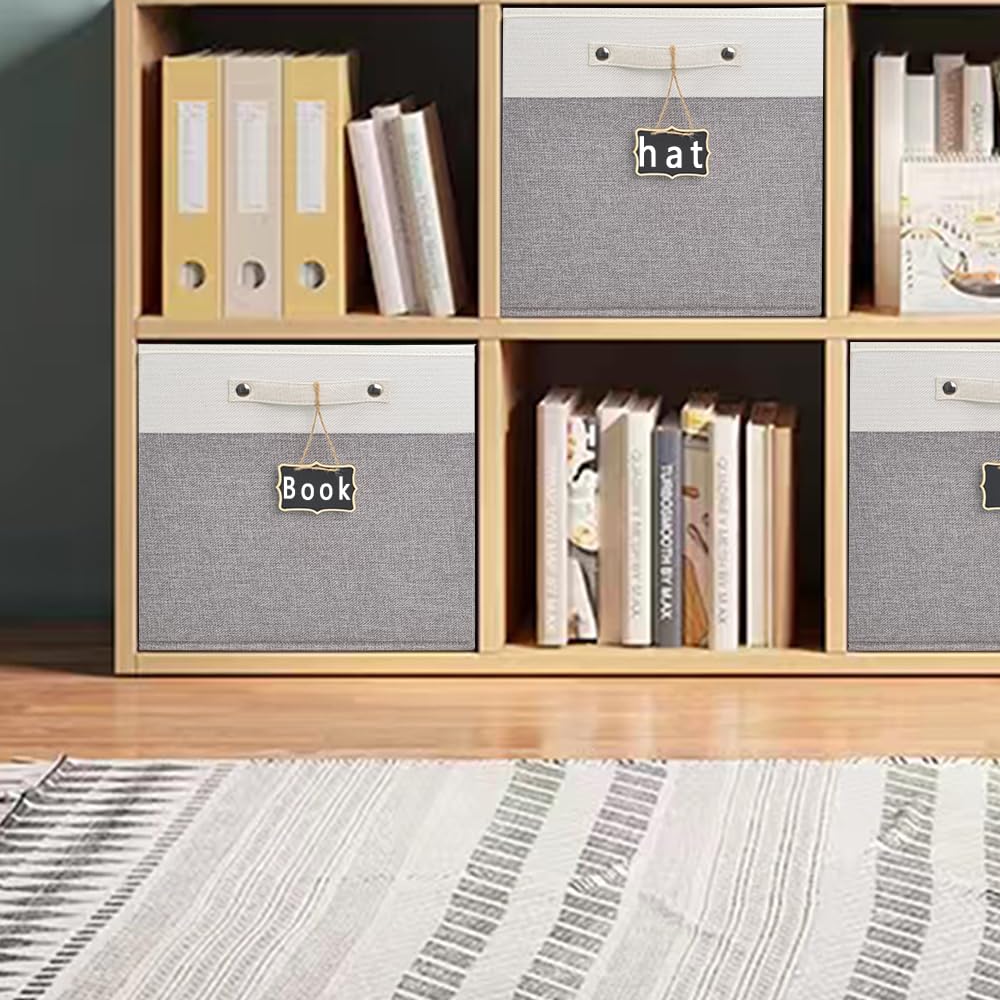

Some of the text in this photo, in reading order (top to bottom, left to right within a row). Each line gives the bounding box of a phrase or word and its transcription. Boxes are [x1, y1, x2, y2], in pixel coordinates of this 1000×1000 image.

[639, 135, 703, 169] hat
[283, 476, 351, 500] Book
[659, 465, 674, 622] TURBOSMOOTH BY MAX
